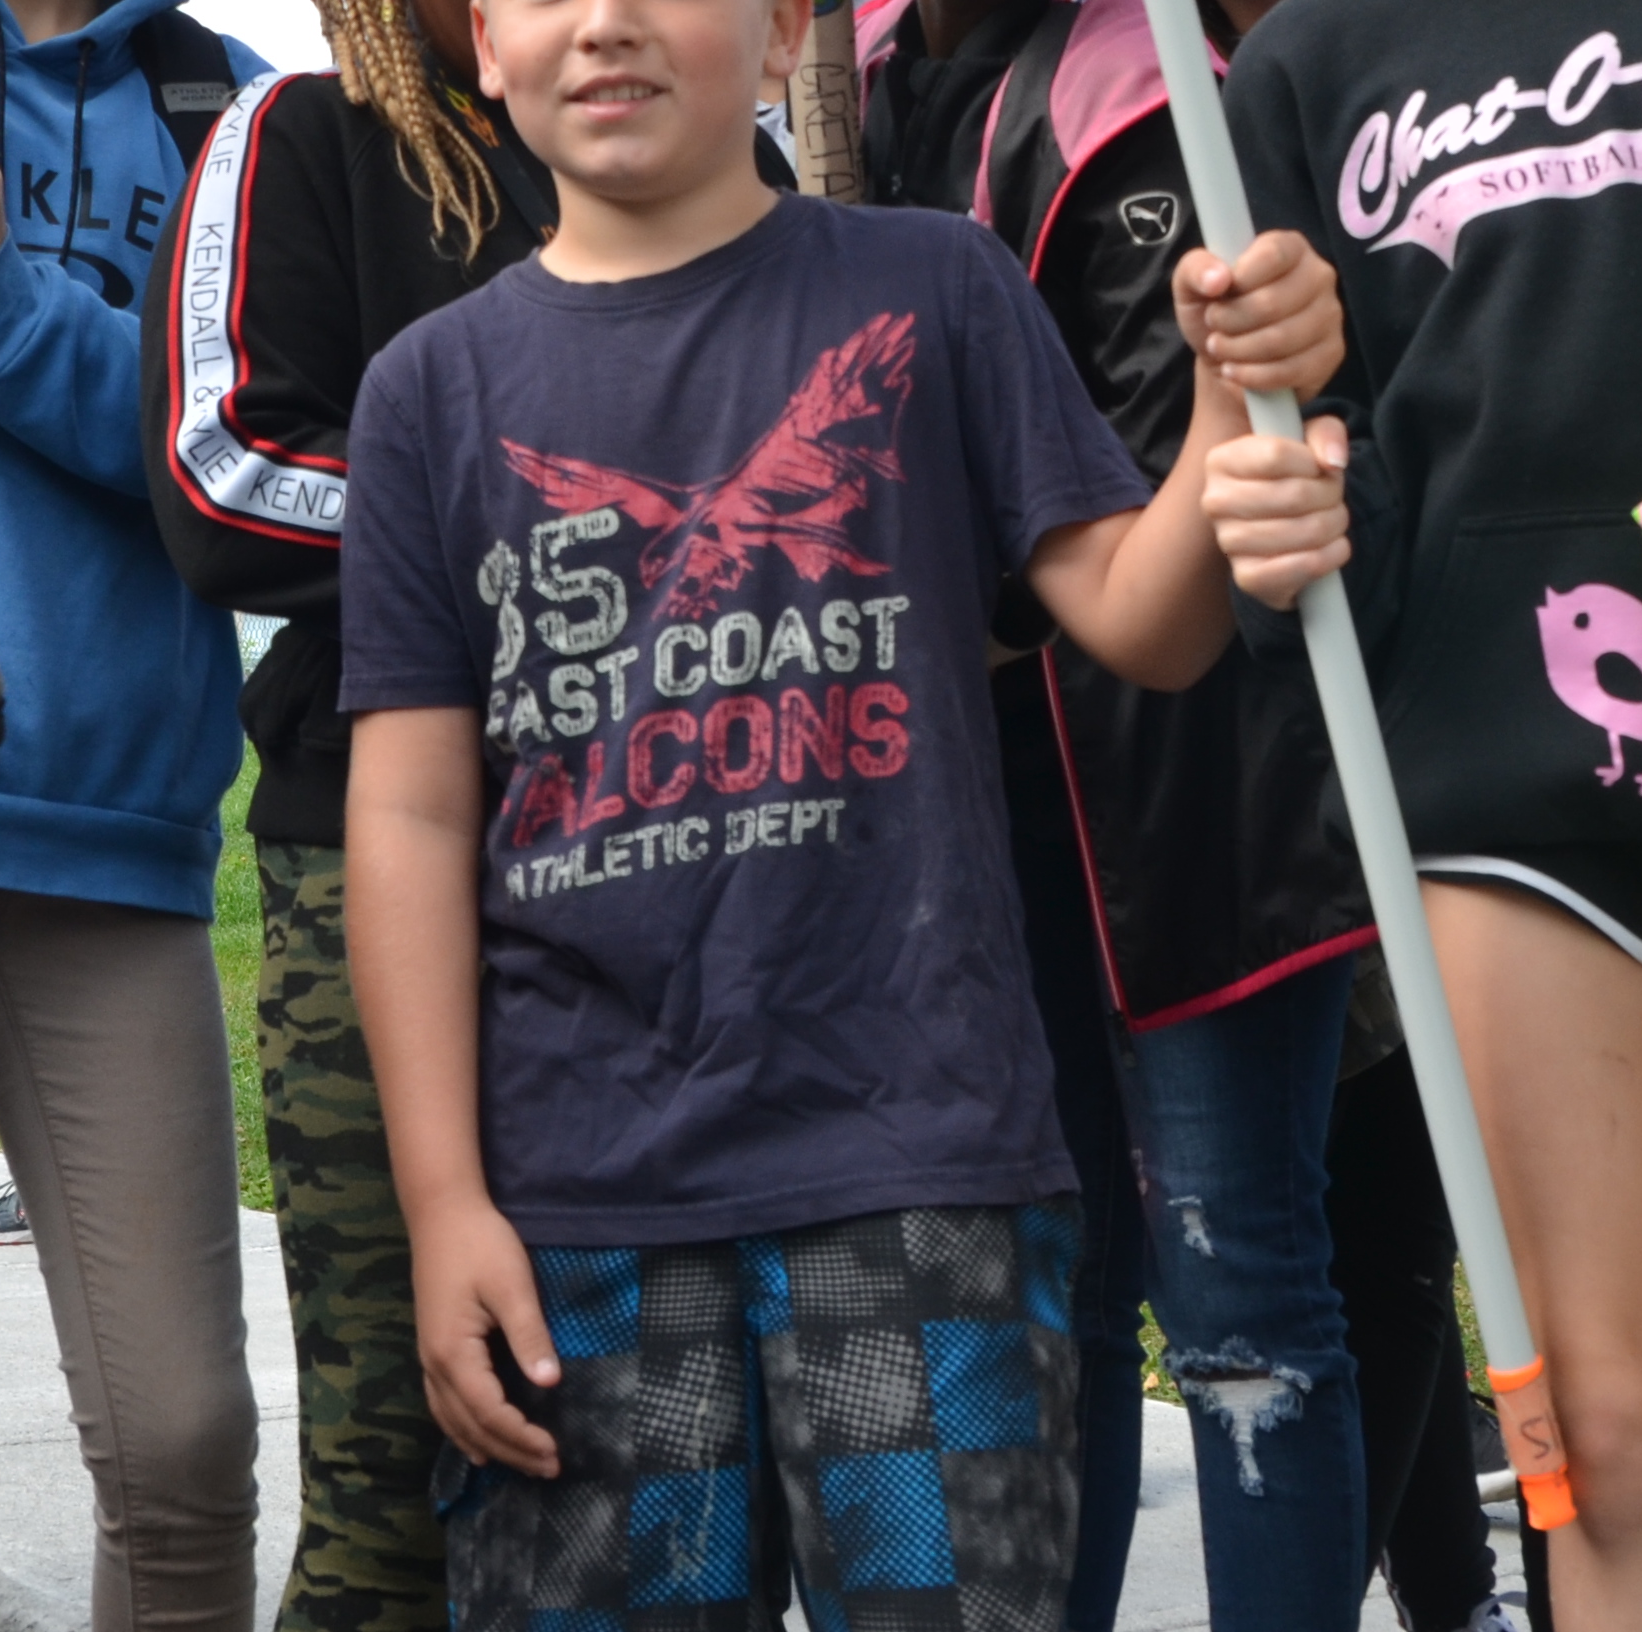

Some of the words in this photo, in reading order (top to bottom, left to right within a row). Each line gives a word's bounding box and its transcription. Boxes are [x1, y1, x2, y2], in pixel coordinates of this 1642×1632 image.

[205, 97, 251, 179] KYLIE
[799, 62, 859, 201] GRETA
[190, 221, 225, 376] KENDALL
[183, 409, 239, 485] YLIE
[653, 596, 911, 698] COAST
[500, 682, 910, 849] ALCONS
[505, 815, 711, 903] ATHLETIC
[724, 798, 846, 856] DEPT
